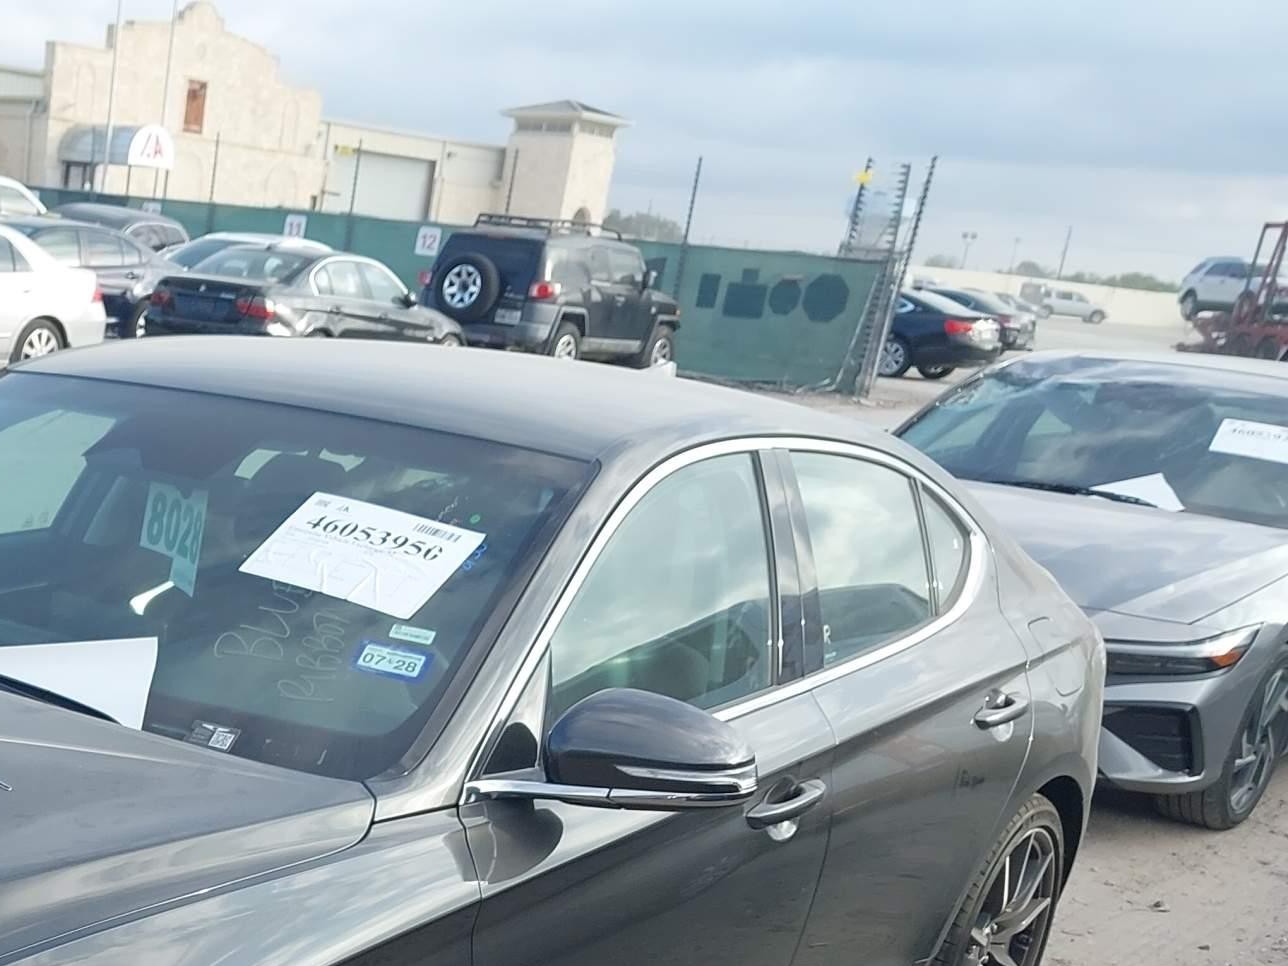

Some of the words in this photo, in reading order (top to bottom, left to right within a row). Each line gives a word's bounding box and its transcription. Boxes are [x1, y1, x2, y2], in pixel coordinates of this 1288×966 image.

[421, 233, 437, 250] 12
[306, 515, 444, 562] 46053950
[362, 652, 387, 666] 07
[393, 659, 418, 673] 28
